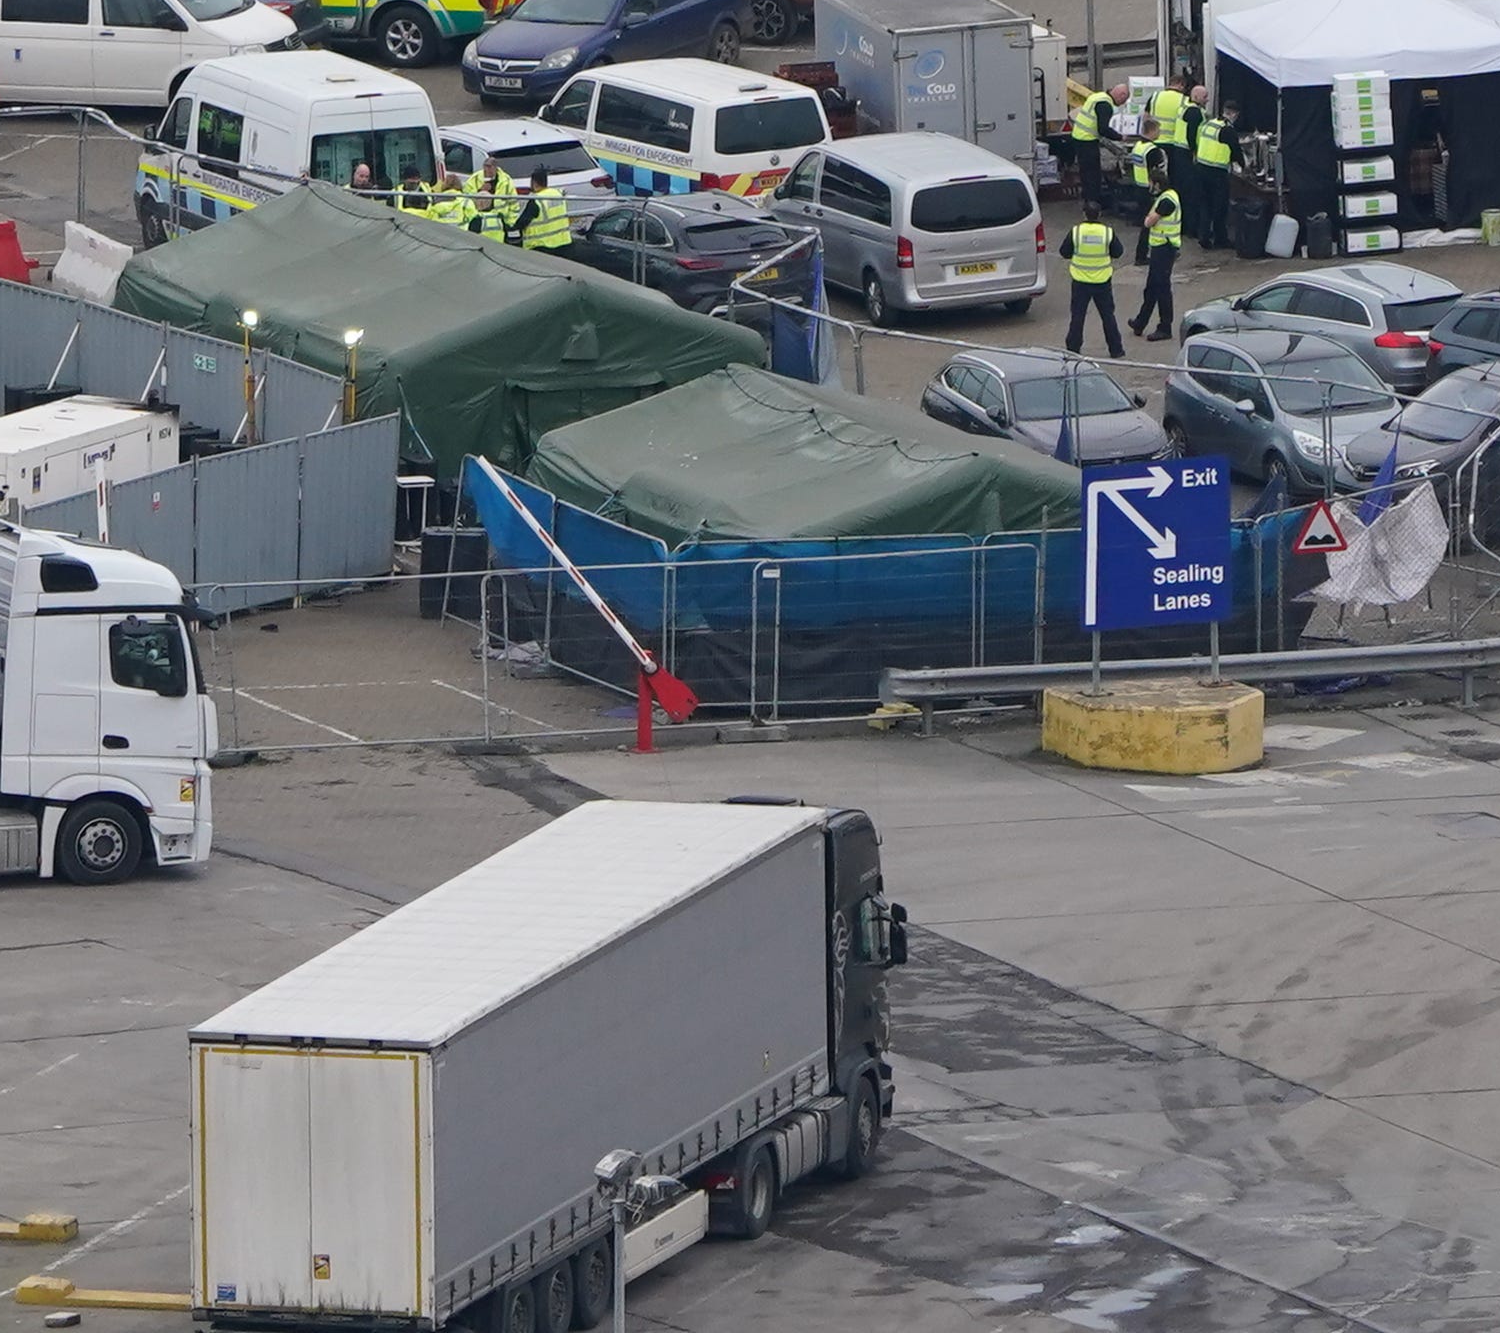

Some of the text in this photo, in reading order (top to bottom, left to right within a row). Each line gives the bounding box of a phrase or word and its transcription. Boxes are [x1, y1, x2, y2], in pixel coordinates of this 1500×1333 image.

[605, 139, 693, 167] IMMIGRATION ENFORCEMENT
[201, 169, 242, 196] IMMIGRATION
[1182, 467, 1218, 488] Exit
[1153, 563, 1224, 586] Sealing
[1154, 593, 1212, 612] Lanes
